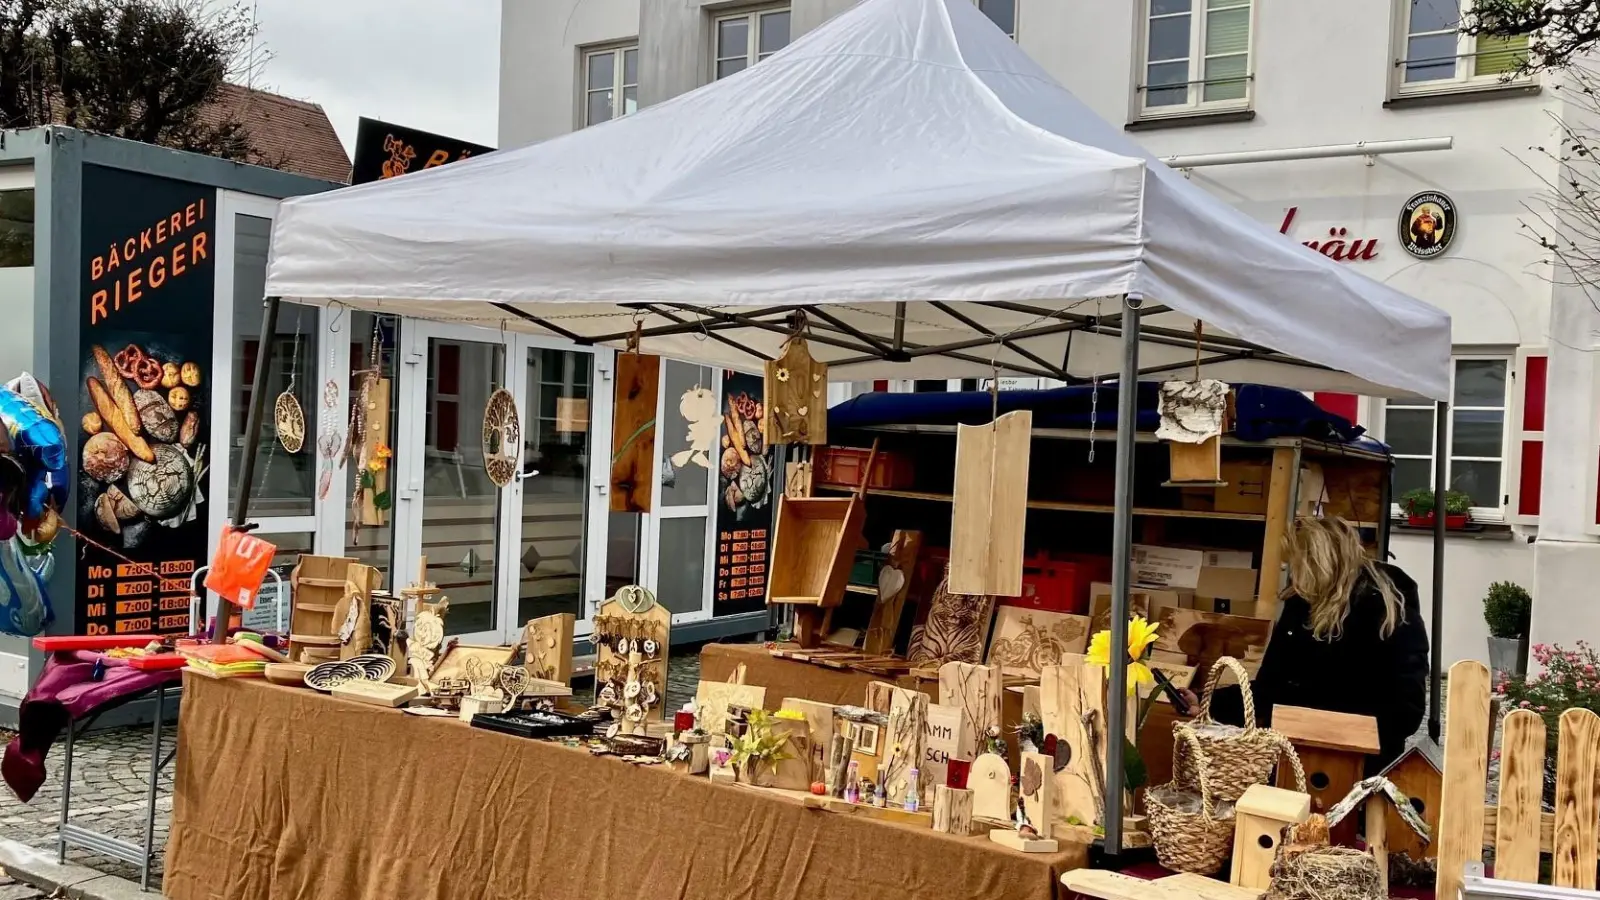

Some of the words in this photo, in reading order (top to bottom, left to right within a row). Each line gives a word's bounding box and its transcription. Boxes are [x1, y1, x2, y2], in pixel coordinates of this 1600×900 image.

[91, 198, 204, 281] BÄCKEREI
[91, 231, 207, 325] RIEGER
[721, 531, 731, 540] Mo
[720, 543, 729, 552] Di
[720, 555, 729, 564] Mi
[88, 565, 112, 579] Mo
[123, 564, 151, 576] 7:00
[160, 561, 193, 574] 18:00
[719, 568, 729, 576] Do
[87, 584, 105, 599] Di
[123, 583, 151, 594] 7:00
[160, 580, 191, 592] 18:00
[719, 579, 727, 588] Fr
[718, 592, 728, 601] Sa
[87, 603, 107, 617] Mi
[122, 601, 150, 612] 7:00
[160, 598, 191, 610] 18:00
[86, 623, 109, 636] Do
[122, 619, 150, 631] 7:00
[159, 617, 190, 628] 18:00
